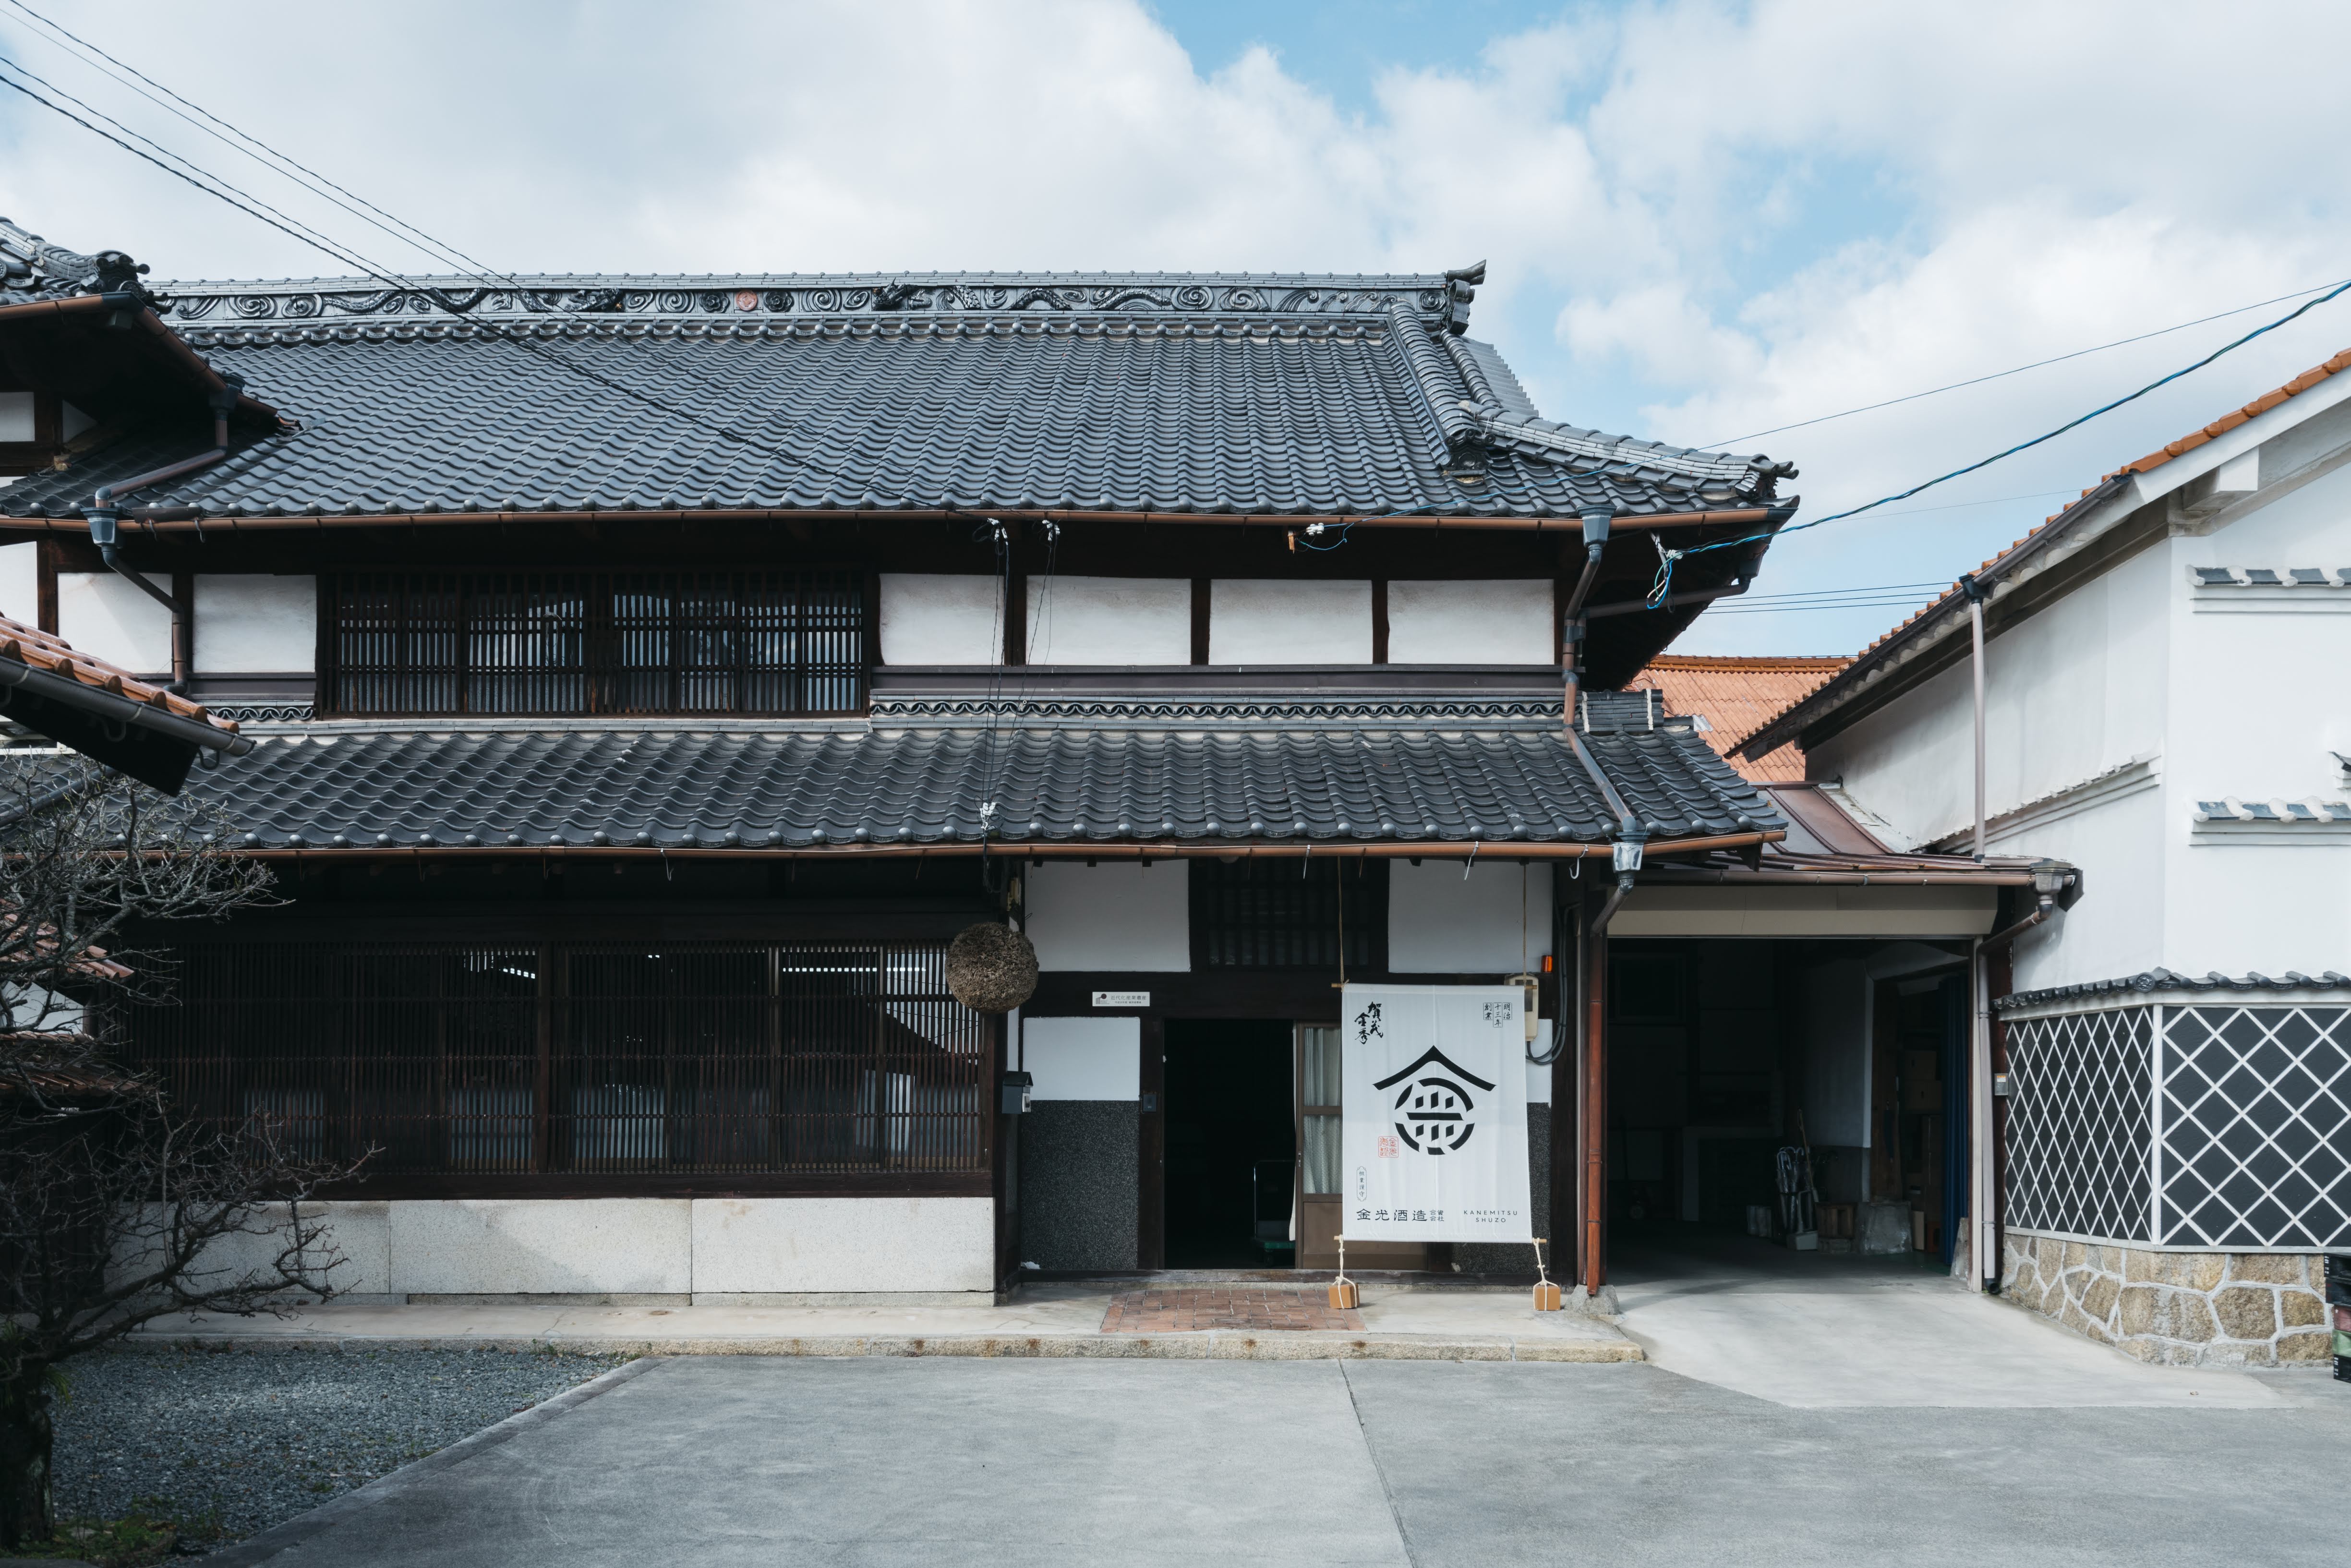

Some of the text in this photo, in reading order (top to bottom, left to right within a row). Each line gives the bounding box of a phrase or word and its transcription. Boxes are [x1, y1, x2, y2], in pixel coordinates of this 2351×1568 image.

[1484, 1003, 1492, 1020] 創業
[1503, 1003, 1510, 1019] 明治
[1356, 1208, 1427, 1221] 金光酒造
